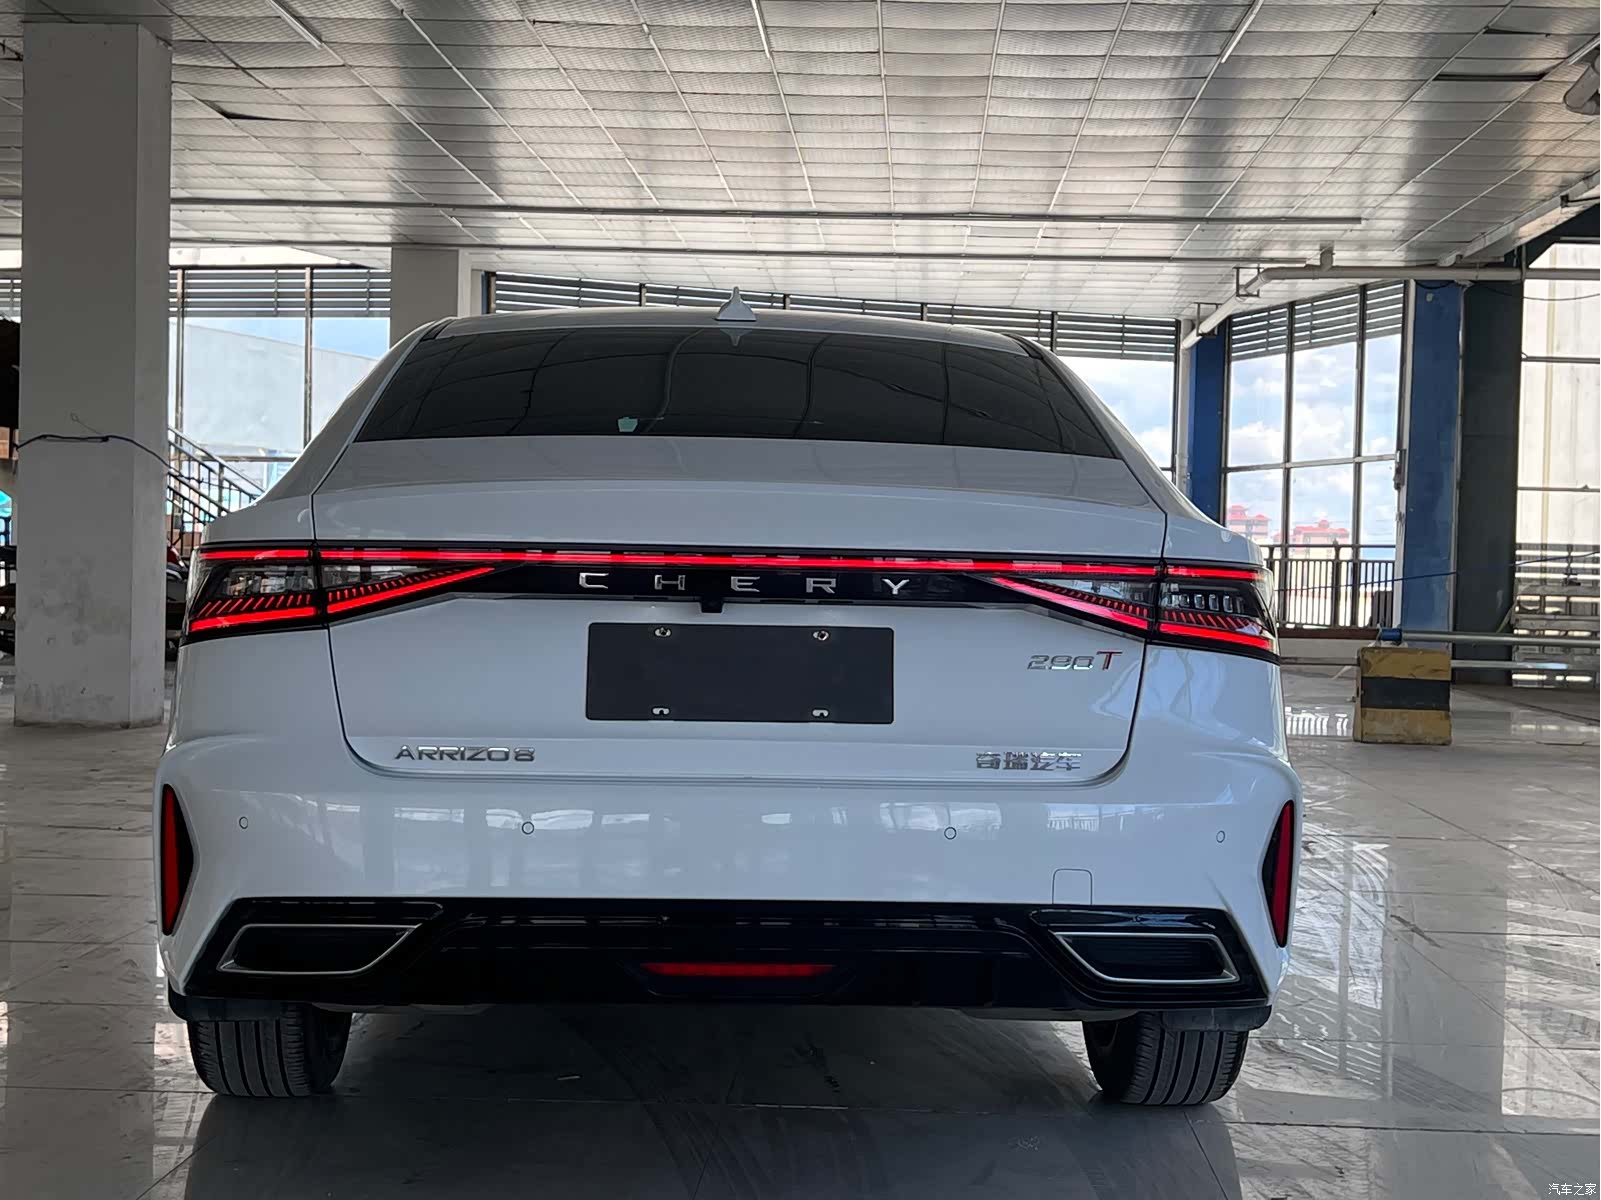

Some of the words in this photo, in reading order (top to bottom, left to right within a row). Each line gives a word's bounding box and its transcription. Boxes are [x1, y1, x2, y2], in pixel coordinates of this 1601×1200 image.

[578, 572, 910, 595] CHERY
[1027, 650, 1123, 671] 290T
[975, 751, 1082, 771] 奇瑞汽车
